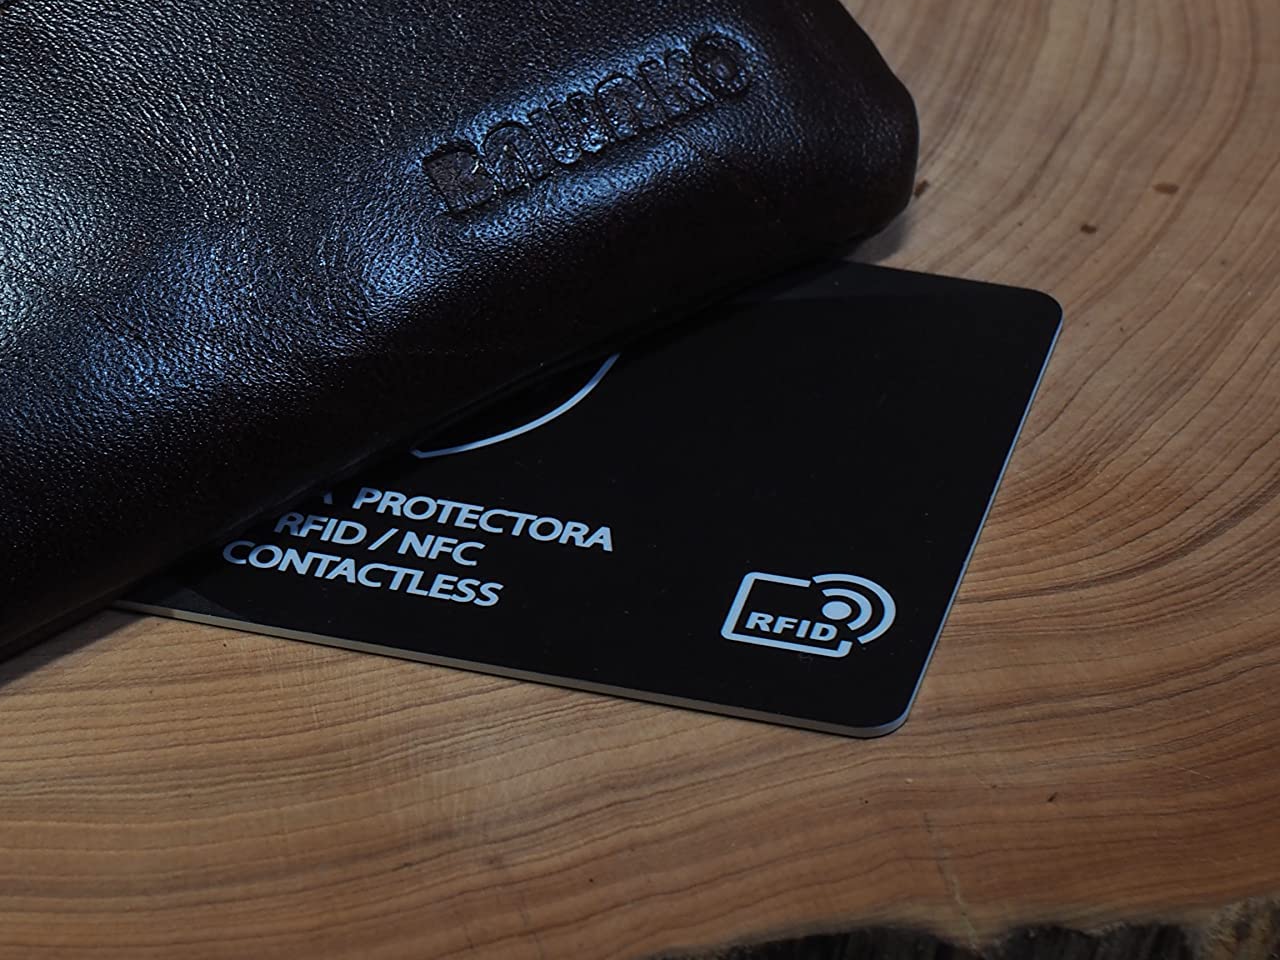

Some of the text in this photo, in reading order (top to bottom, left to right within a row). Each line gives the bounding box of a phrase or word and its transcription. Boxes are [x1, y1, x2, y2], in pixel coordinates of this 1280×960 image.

[274, 511, 367, 545] RFID
[397, 531, 486, 566] NFC
[352, 487, 614, 552] PROTECTORA
[222, 540, 504, 607] CONTACTLESS
[744, 611, 838, 642] RFID
